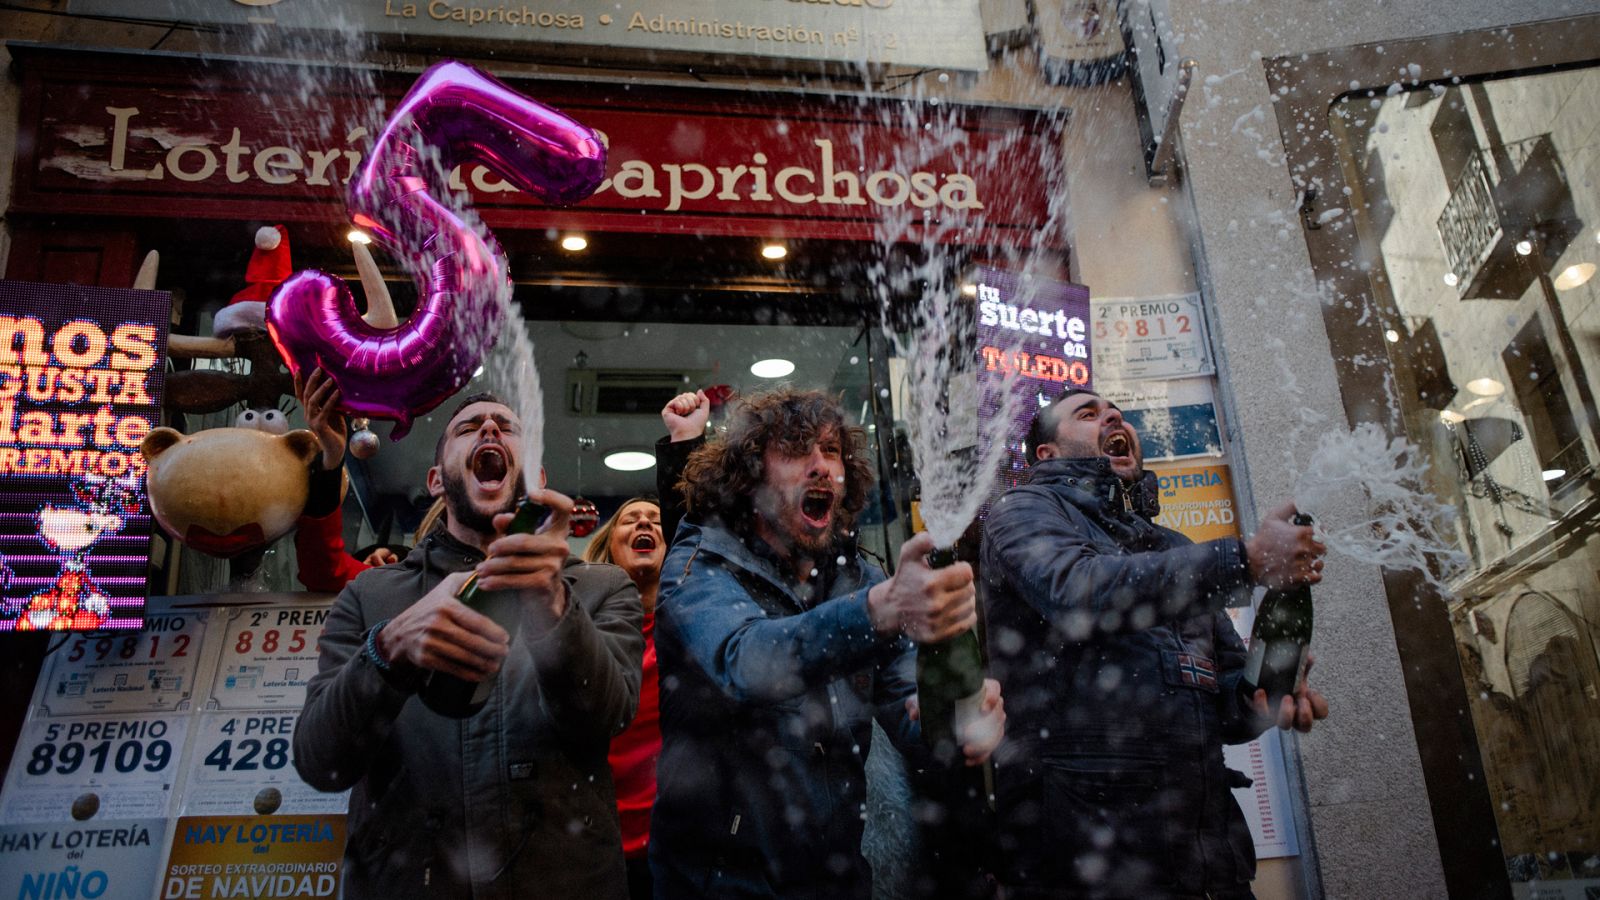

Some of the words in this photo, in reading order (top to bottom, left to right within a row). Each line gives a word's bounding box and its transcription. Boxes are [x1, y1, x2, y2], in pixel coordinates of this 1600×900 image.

[385, 0, 417, 17] La
[428, 0, 584, 29] Caprichosa
[627, 11, 824, 45] Administración
[105, 106, 367, 186] Loterí
[594, 129, 984, 211] aprichosa
[978, 283, 1000, 302] tu
[979, 300, 1086, 342] suerte
[1120, 302, 1180, 317] PREMIO
[0, 314, 158, 370] nos
[1063, 341, 1088, 358] en
[982, 346, 1089, 385] TOLEDO
[0, 447, 148, 477] REMIOS
[1157, 469, 1223, 489] OTERÍA
[1155, 508, 1234, 528] AVIDAD
[143, 616, 186, 632] MIO
[276, 609, 331, 626] PREM
[67, 720, 168, 741] PREMIO
[244, 716, 294, 735] PRE
[26, 740, 172, 776] 89109
[204, 737, 297, 771] 428
[0, 831, 47, 851] HAY
[51, 824, 150, 849] LOTERÍA
[185, 824, 232, 845] HAY
[236, 820, 334, 844] LOTERÍA
[66, 850, 85, 860] del
[253, 843, 270, 854] del
[170, 864, 222, 876] SORTEO
[225, 862, 337, 875] EXTRAORDINARIO
[18, 865, 109, 900] NIÑO
[165, 876, 204, 900] DE
[211, 874, 336, 899] NAVIDAD
